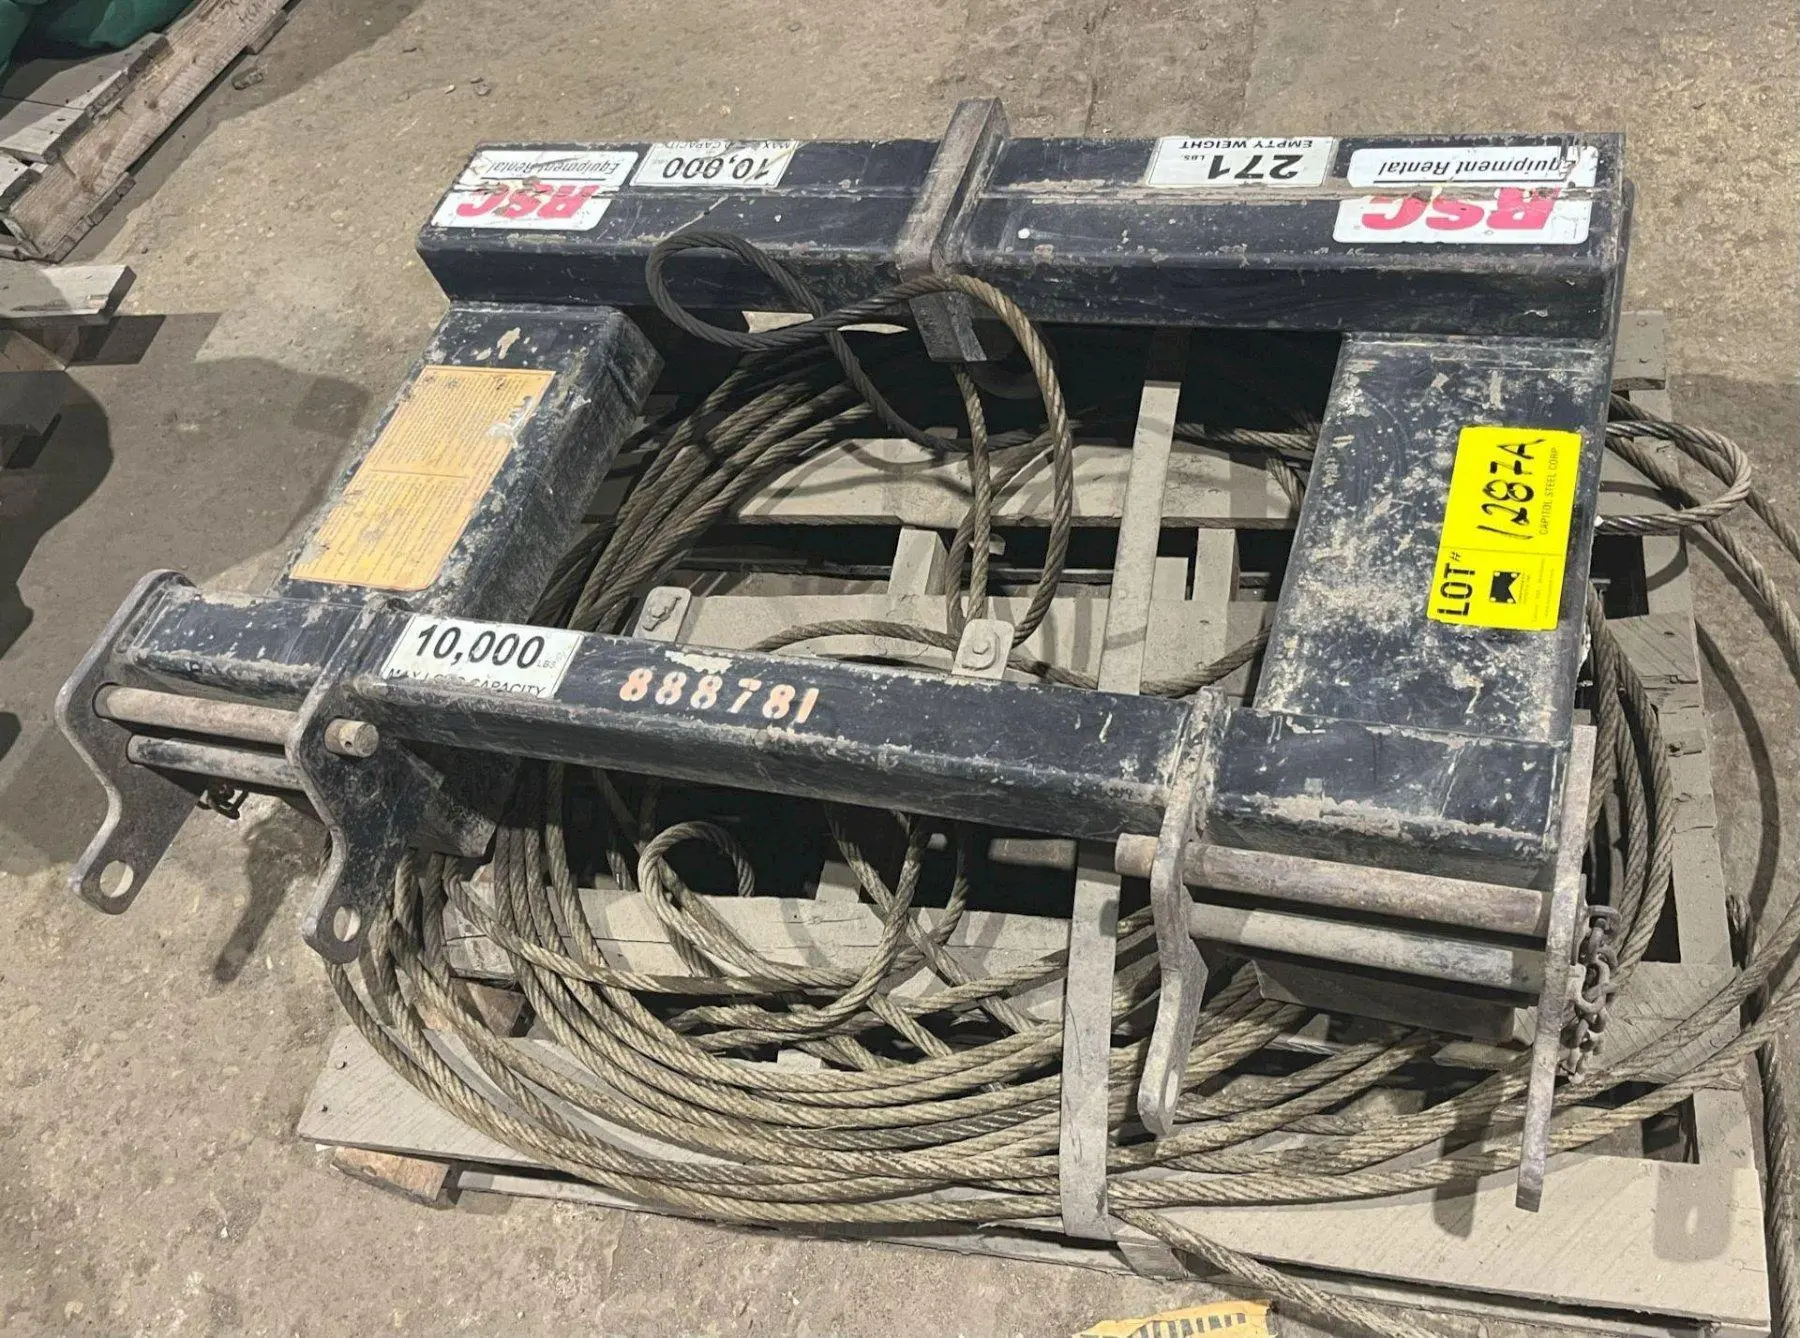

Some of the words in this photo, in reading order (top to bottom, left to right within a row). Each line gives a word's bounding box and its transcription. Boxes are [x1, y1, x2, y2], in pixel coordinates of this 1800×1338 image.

[1179, 140, 1248, 149] WEIGHT
[1253, 140, 1313, 149] EMPTY
[1207, 154, 1304, 180] 271
[1378, 160, 1451, 176] Rental
[456, 182, 600, 219] RSC
[1361, 186, 1560, 231] RSC
[1547, 446, 1561, 470] CORP
[1544, 471, 1558, 499] STEEL
[1538, 501, 1552, 536] CAPITOL
[416, 623, 546, 669] 10,000
[618, 667, 821, 724] 888781
